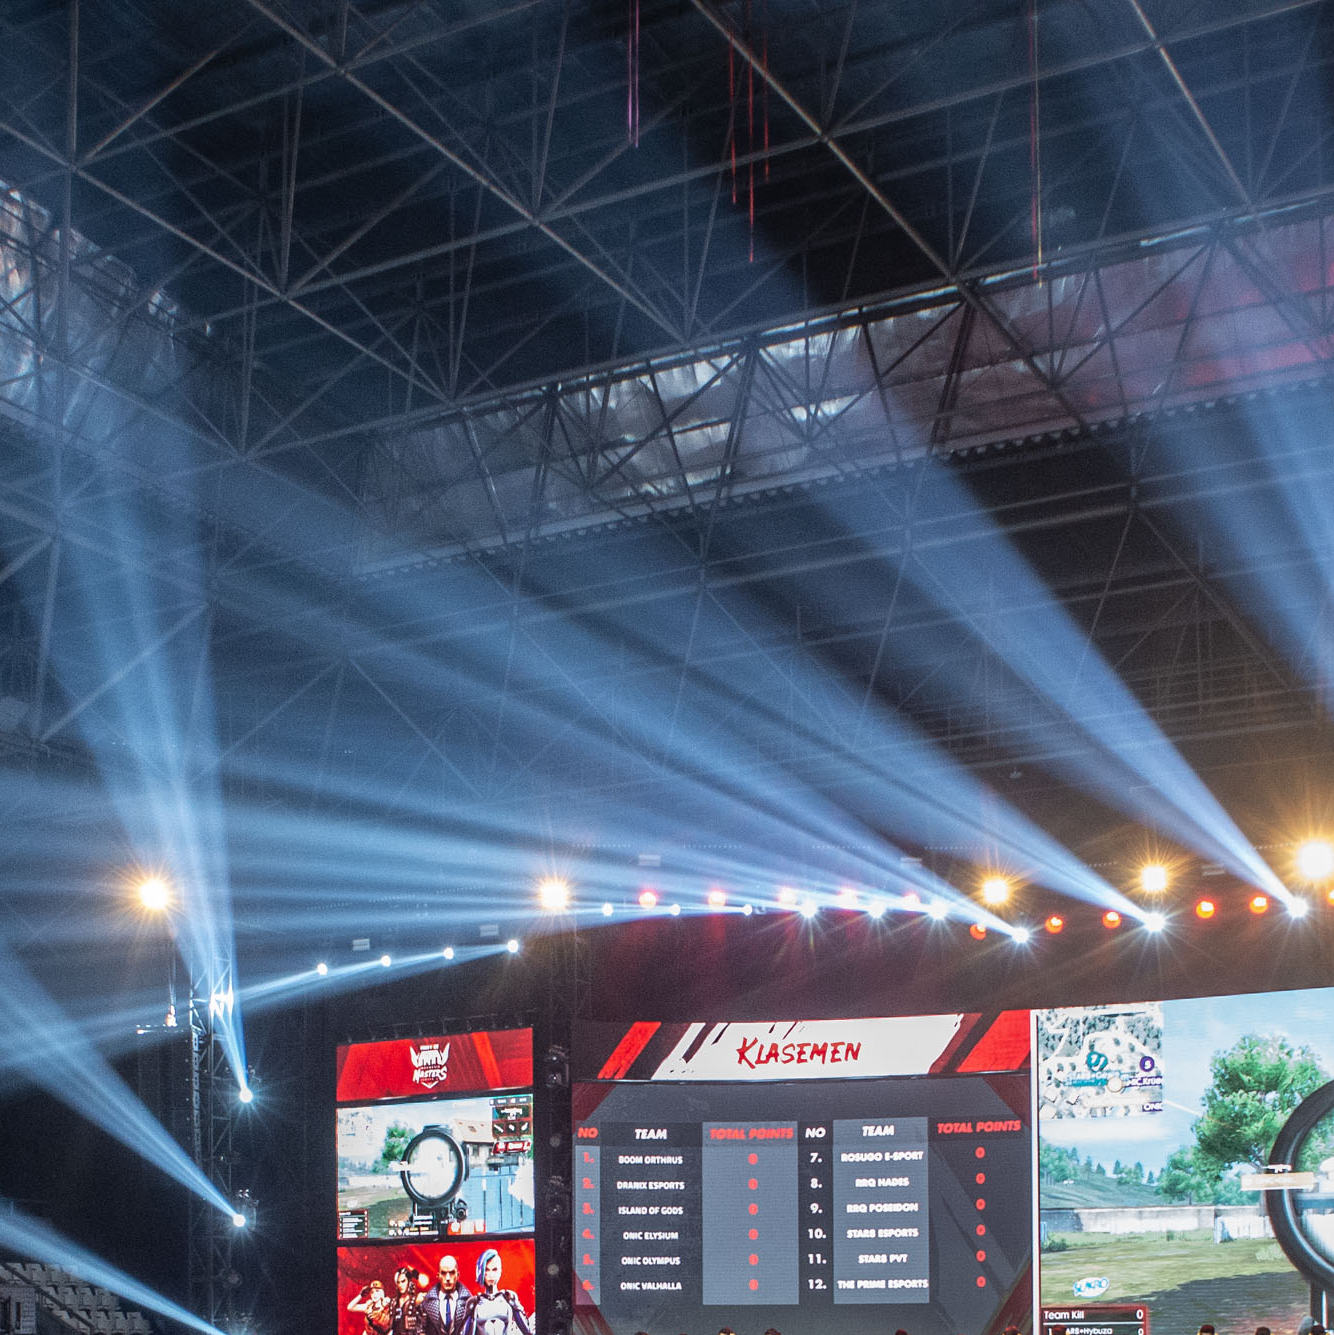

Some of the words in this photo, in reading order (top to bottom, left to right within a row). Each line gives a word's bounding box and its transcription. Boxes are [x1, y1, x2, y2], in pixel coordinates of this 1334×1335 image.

[736, 1036, 862, 1069] KLASEMEN
[577, 1127, 598, 1139] NO
[635, 1128, 667, 1139] TEAM
[710, 1127, 745, 1139] TOTAL
[748, 1127, 794, 1139] POINTS
[805, 1127, 827, 1138] NO
[862, 1125, 895, 1137] TEAM
[937, 1122, 973, 1133] TOTAL
[976, 1120, 1021, 1132] POINTS
[618, 1155, 643, 1165] BOOM
[644, 1155, 683, 1165] ORTHRUS
[810, 1153, 823, 1163] 7.
[884, 1151, 924, 1161] E-SPORT
[648, 1181, 685, 1190] ESPORTS
[810, 1178, 823, 1189] 8.
[878, 1177, 910, 1187] HADES
[618, 1206, 647, 1215] ISLAND
[649, 1206, 660, 1215] OF
[661, 1206, 684, 1215] GODS
[810, 1203, 823, 1214] 9.
[869, 1203, 919, 1213] POSEIDON
[623, 1231, 643, 1240] ONIC
[644, 1231, 679, 1240] ELYSIUM
[808, 1229, 827, 1239] 10.
[878, 1228, 919, 1238] ESPORTS
[621, 1256, 642, 1265] ONIC
[642, 1256, 681, 1265] OLYMPUS
[808, 1254, 827, 1265] 11.
[889, 1254, 908, 1264] PVT
[620, 1281, 641, 1291] ONIC
[641, 1281, 682, 1291] VALHALLA
[808, 1279, 827, 1290] 12.
[837, 1280, 855, 1289] THE
[887, 1279, 929, 1289] ESPORTS
[1043, 1310, 1070, 1320] Team
[1071, 1310, 1085, 1319] Kill
[1136, 1309, 1144, 1320] 0
